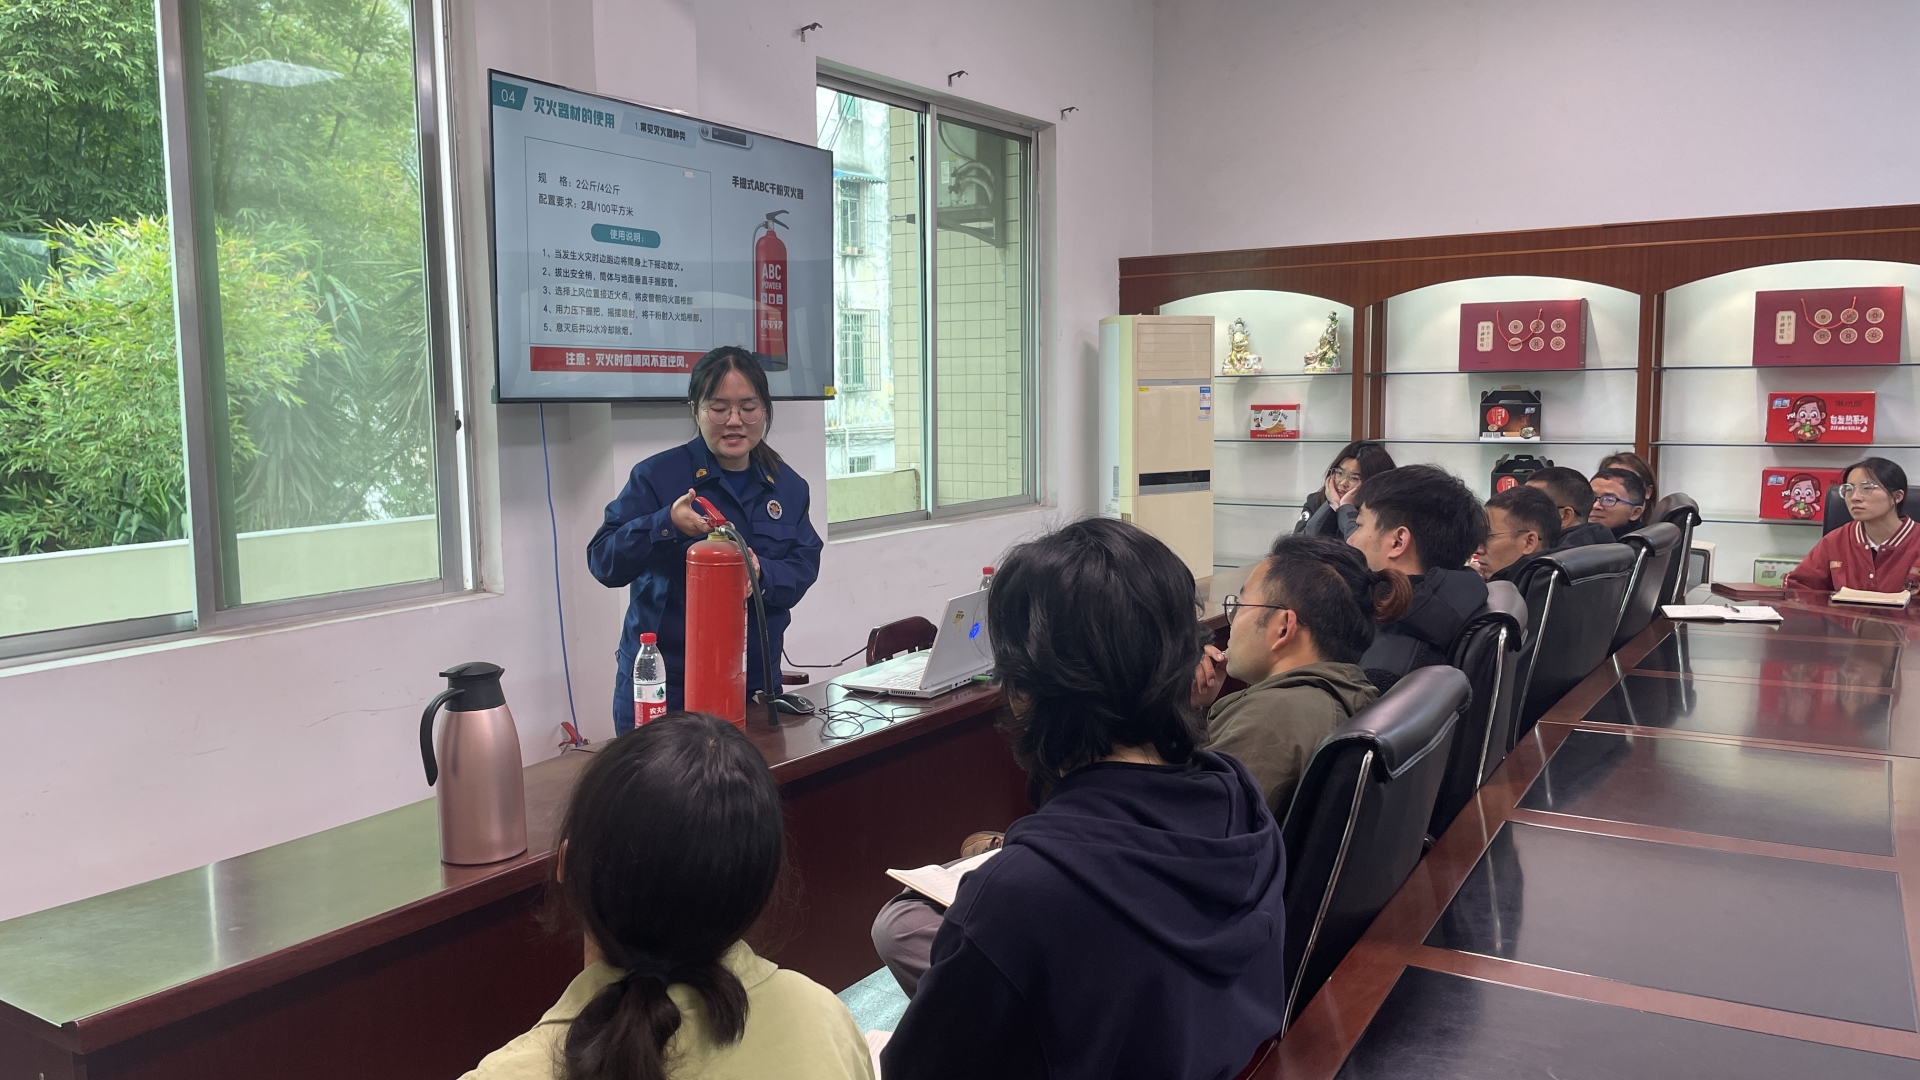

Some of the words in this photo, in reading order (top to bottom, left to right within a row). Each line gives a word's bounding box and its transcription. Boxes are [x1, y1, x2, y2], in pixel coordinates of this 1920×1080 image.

[501, 88, 516, 104] 04
[533, 96, 615, 129] 灭火器材的使用
[732, 175, 804, 200] 手提式ABC干粉灭火器
[761, 263, 782, 281] ABC
[761, 281, 782, 290] POWDER
